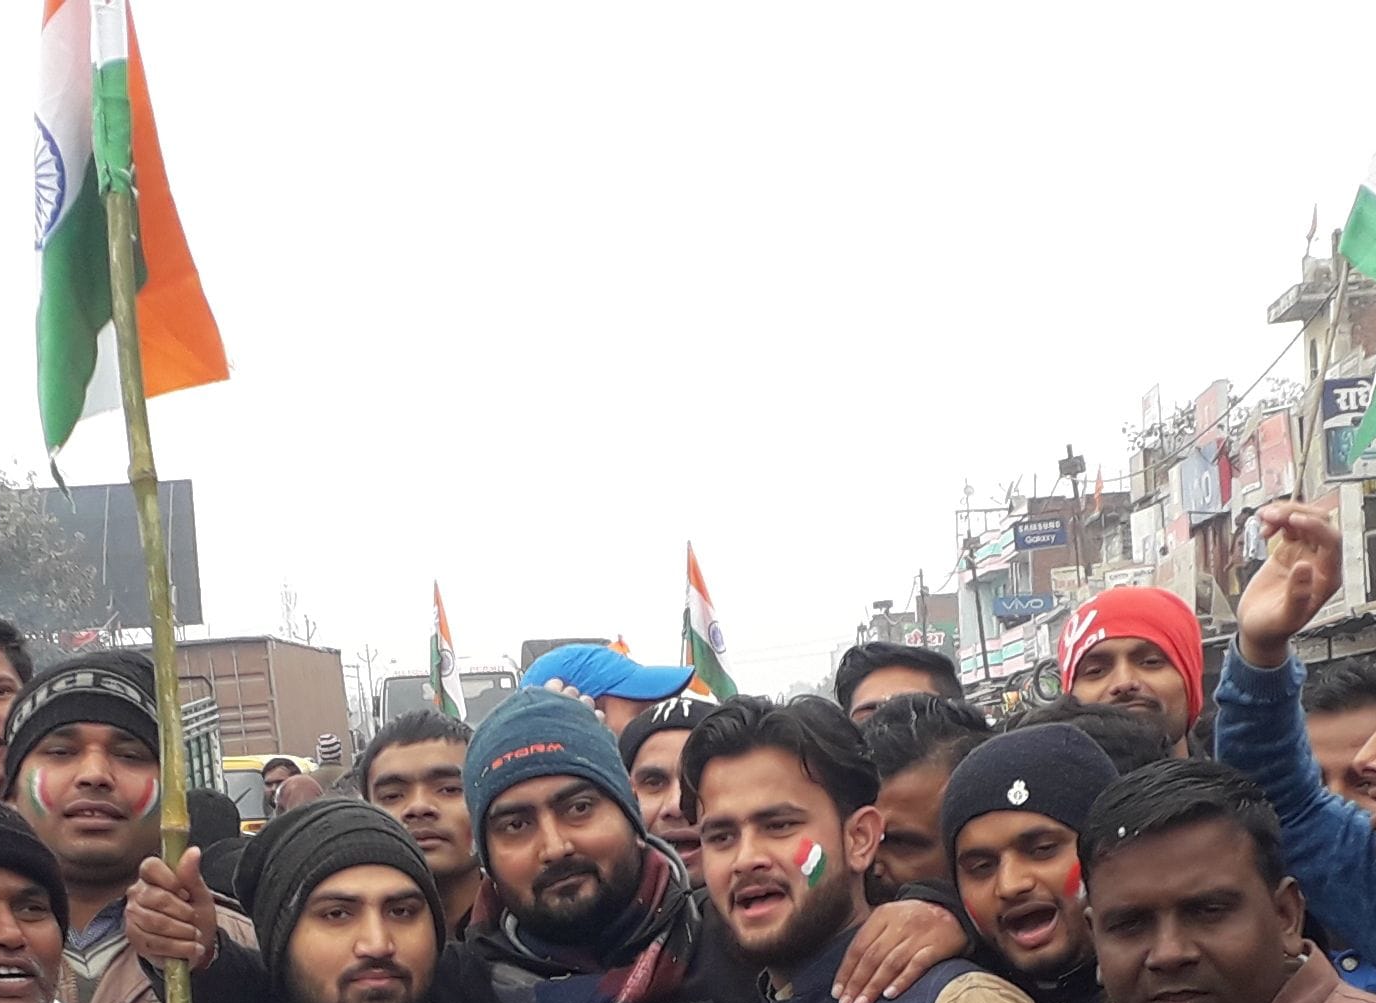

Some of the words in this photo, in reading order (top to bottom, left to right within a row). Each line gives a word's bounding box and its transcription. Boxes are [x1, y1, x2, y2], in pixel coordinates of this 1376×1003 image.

[1018, 520, 1061, 533] SAMSUNG
[1024, 533, 1056, 545] Galaxy
[491, 742, 564, 770] STORM
